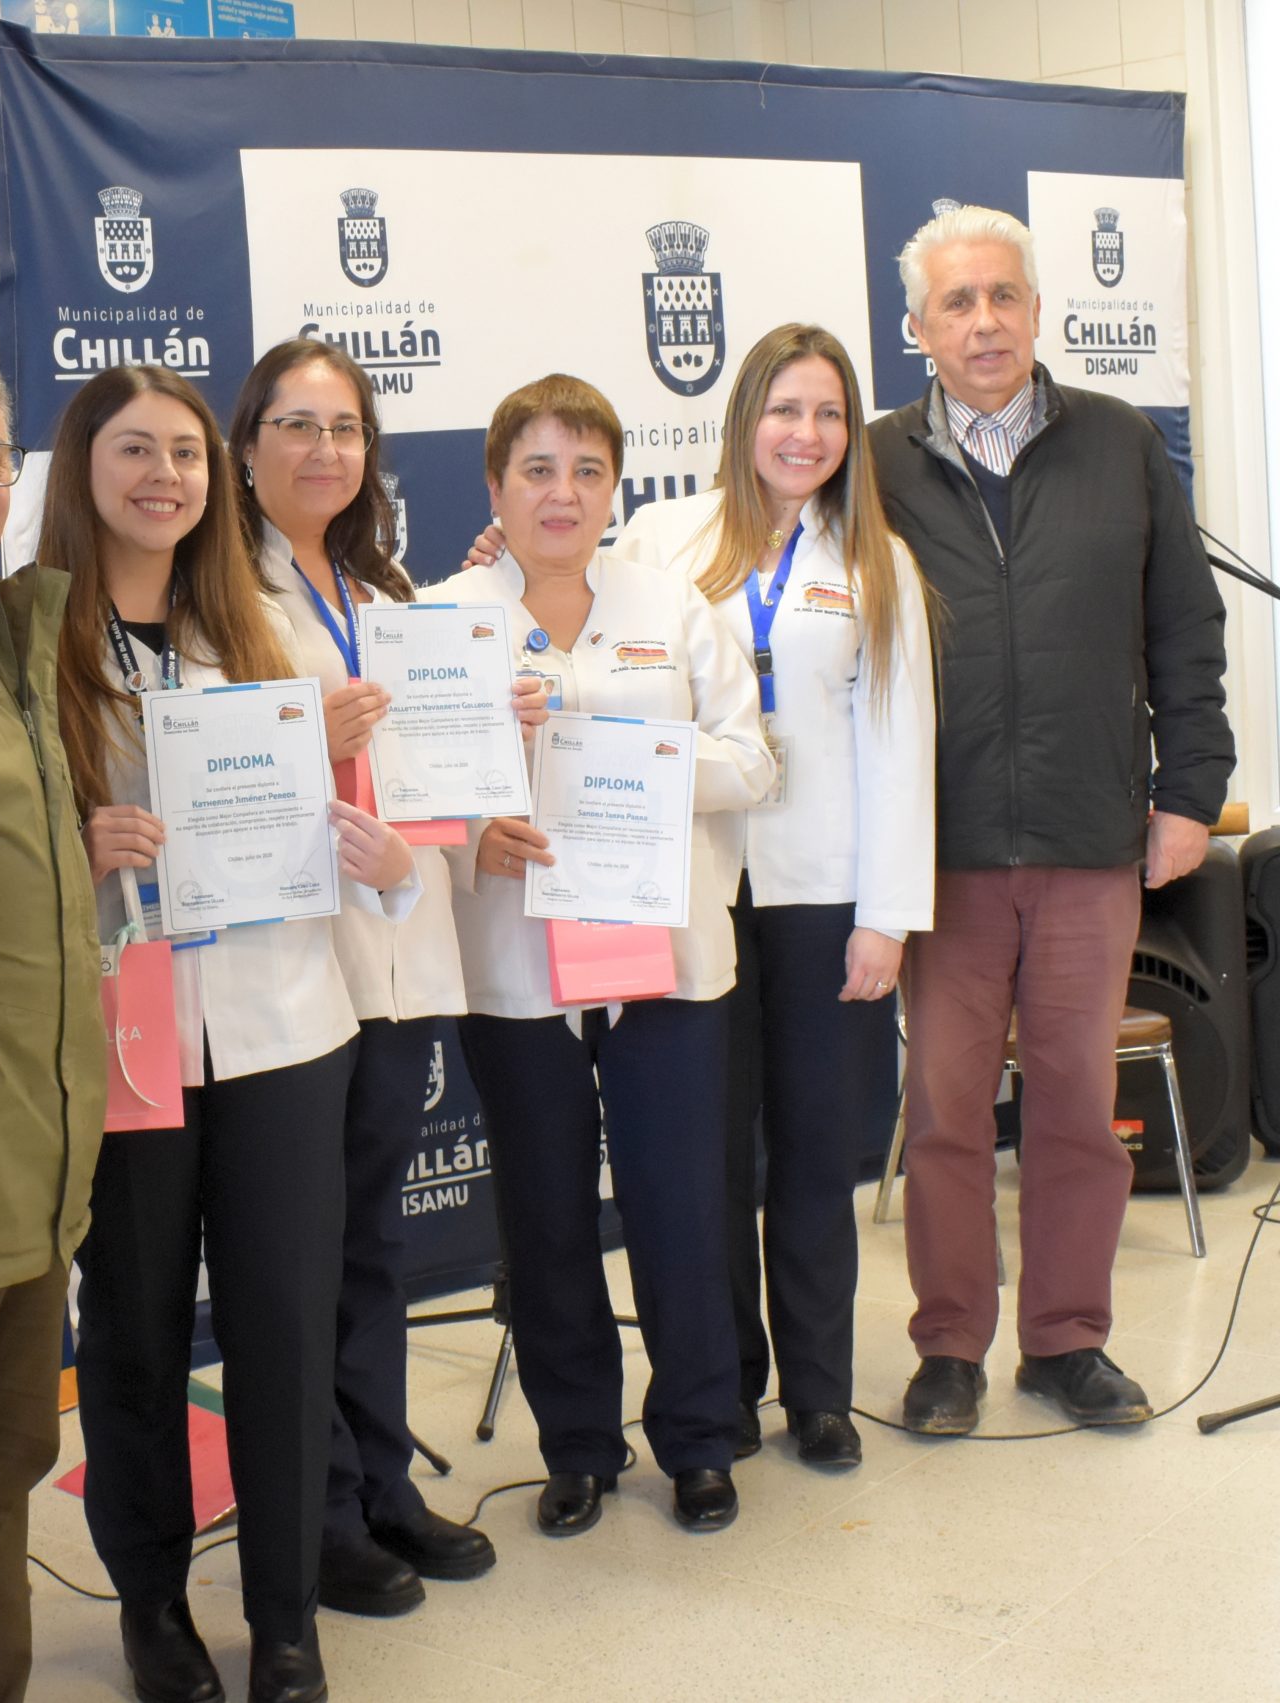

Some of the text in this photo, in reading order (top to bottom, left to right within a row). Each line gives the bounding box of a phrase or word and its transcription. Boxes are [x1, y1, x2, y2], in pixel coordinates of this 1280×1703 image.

[304, 301, 435, 318] Municipalidad de
[1067, 298, 1154, 313] Municipalidad de
[58, 305, 205, 325] Municipalidad de
[1086, 358, 1138, 375] DISAMU
[370, 372, 413, 395] AMU
[625, 420, 722, 452] nicipali
[407, 667, 468, 681] DIPLOMA
[207, 753, 275, 773] DIPLOMA
[584, 775, 645, 792] DIPLOMA
[402, 1184, 469, 1216] ISAMU
